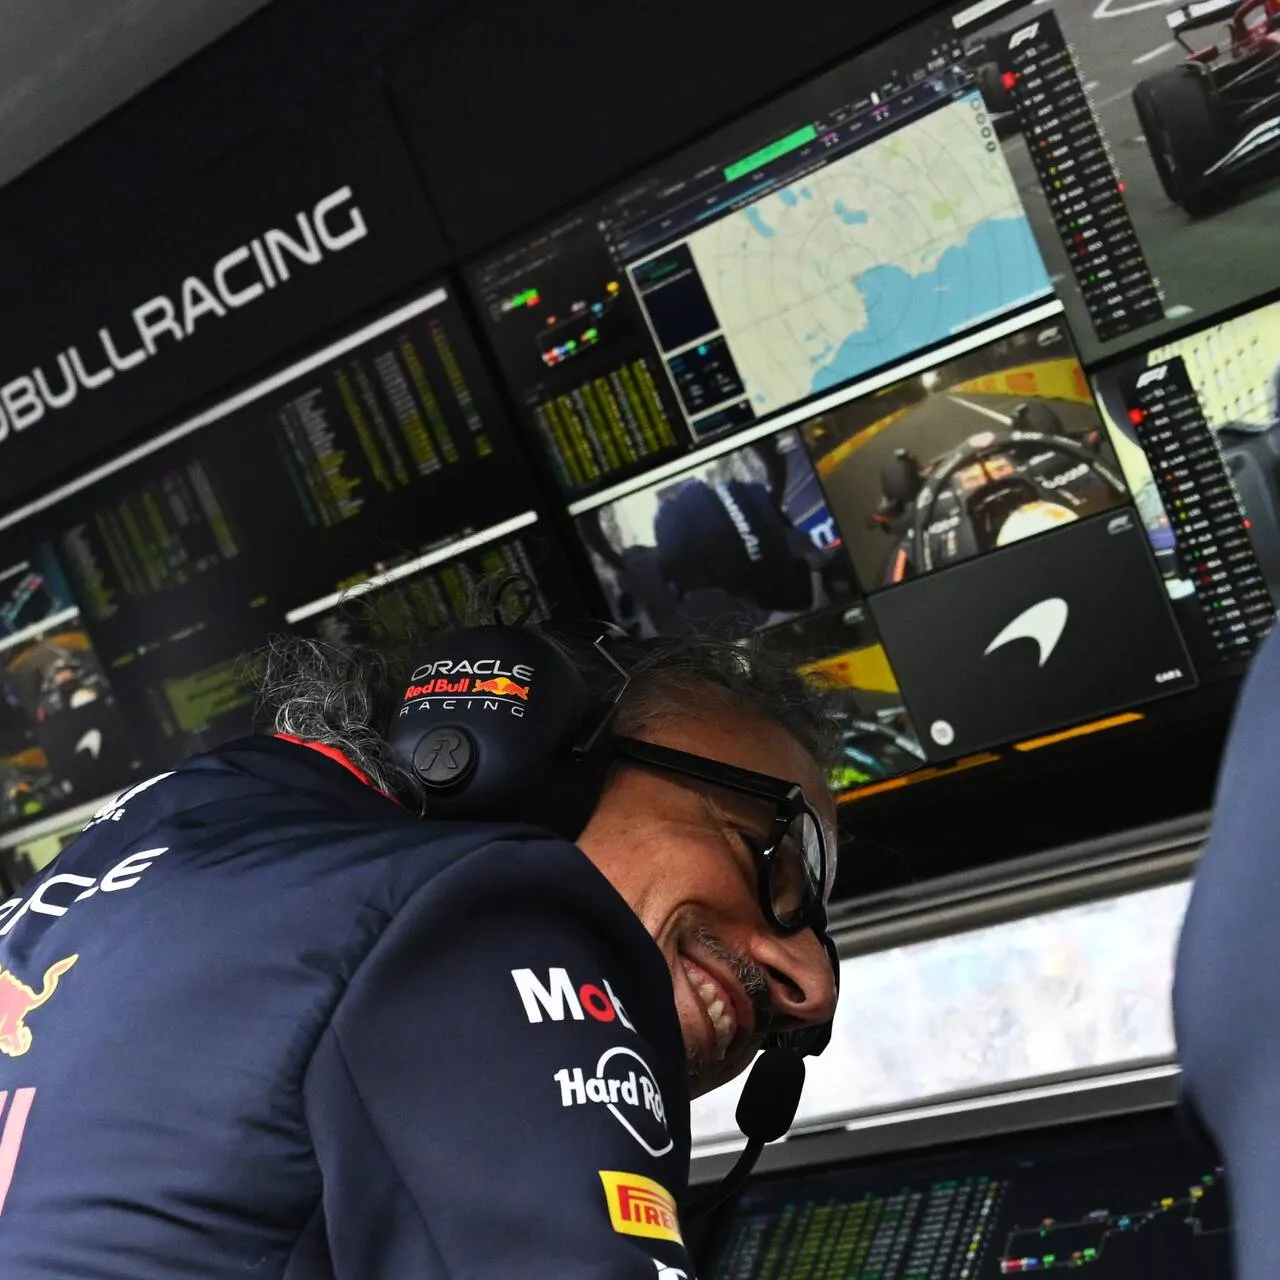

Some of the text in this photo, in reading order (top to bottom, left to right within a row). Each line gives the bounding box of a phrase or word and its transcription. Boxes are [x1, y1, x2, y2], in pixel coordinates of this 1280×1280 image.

[411, 660, 535, 682] ORACLE
[404, 677, 470, 700] Red Bull
[399, 700, 526, 718] RACING
[554, 1067, 639, 1107] Hard
